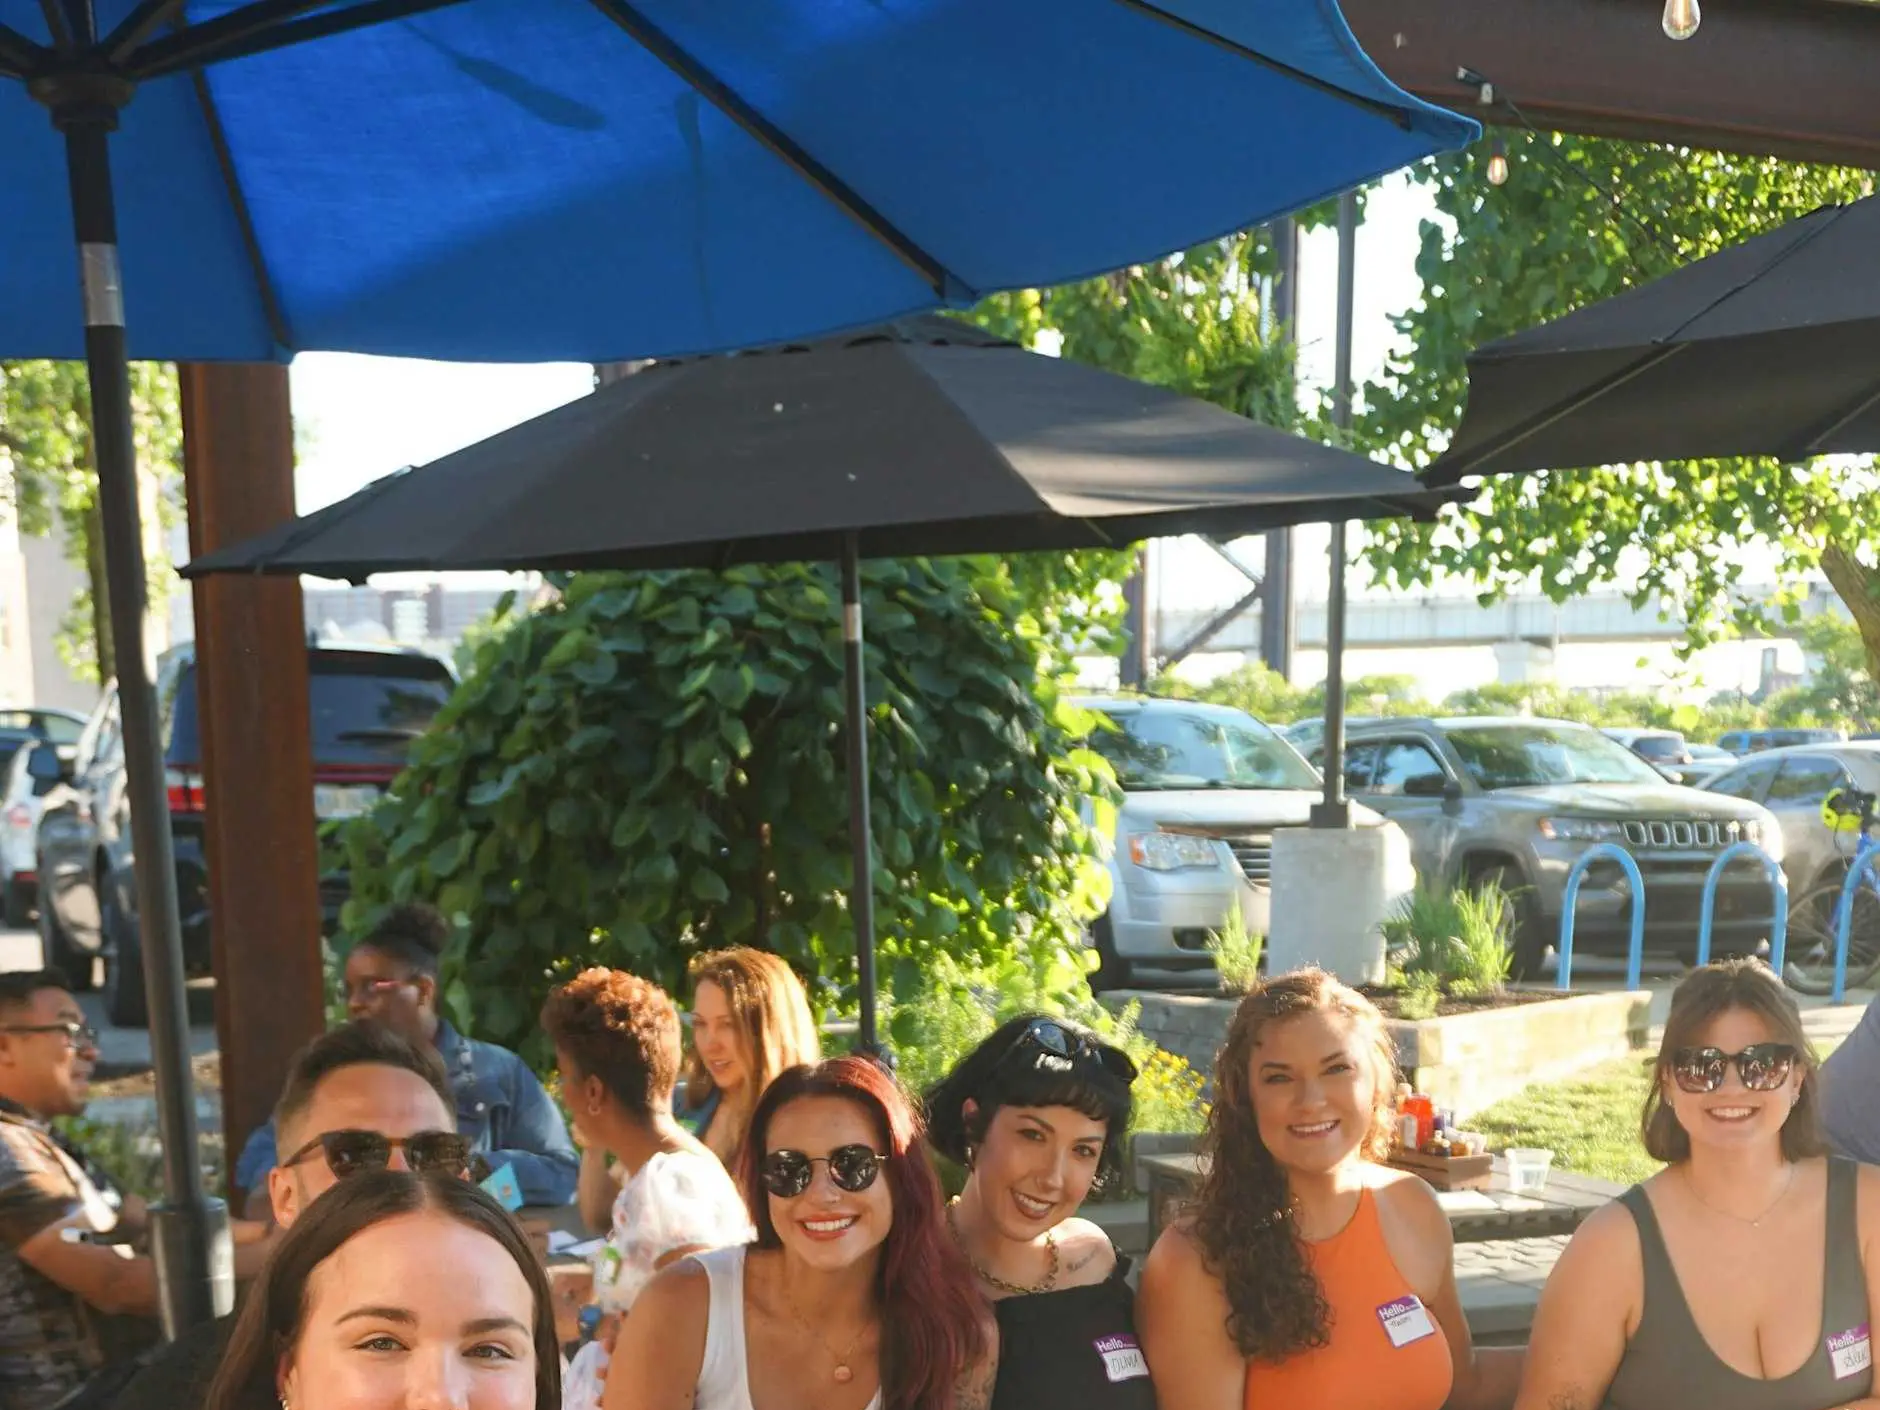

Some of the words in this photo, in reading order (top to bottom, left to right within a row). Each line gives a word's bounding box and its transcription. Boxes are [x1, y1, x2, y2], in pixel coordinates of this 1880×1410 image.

[1378, 1304, 1405, 1320] Hello
[1096, 1337, 1123, 1352] Hello
[1828, 1334, 1855, 1351] Hello
